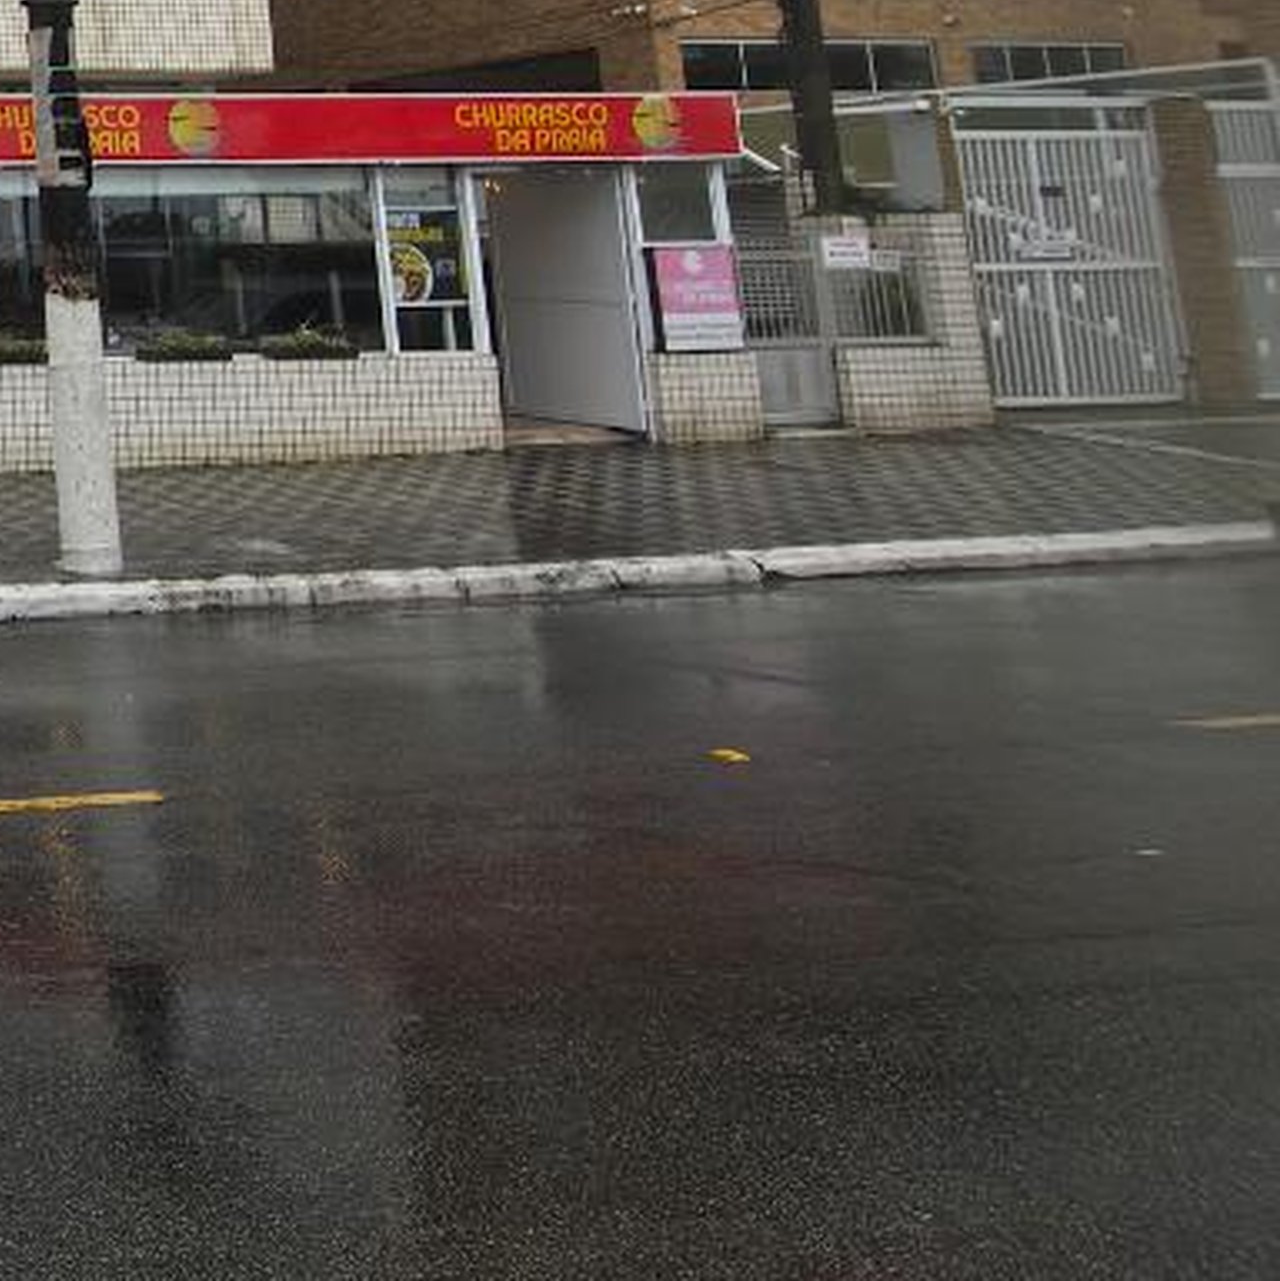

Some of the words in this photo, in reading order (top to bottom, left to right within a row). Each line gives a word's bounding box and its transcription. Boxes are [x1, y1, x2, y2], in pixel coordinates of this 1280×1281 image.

[454, 102, 608, 128] CHURRASCO
[496, 128, 531, 152] DA
[535, 128, 607, 152] PRAIA
